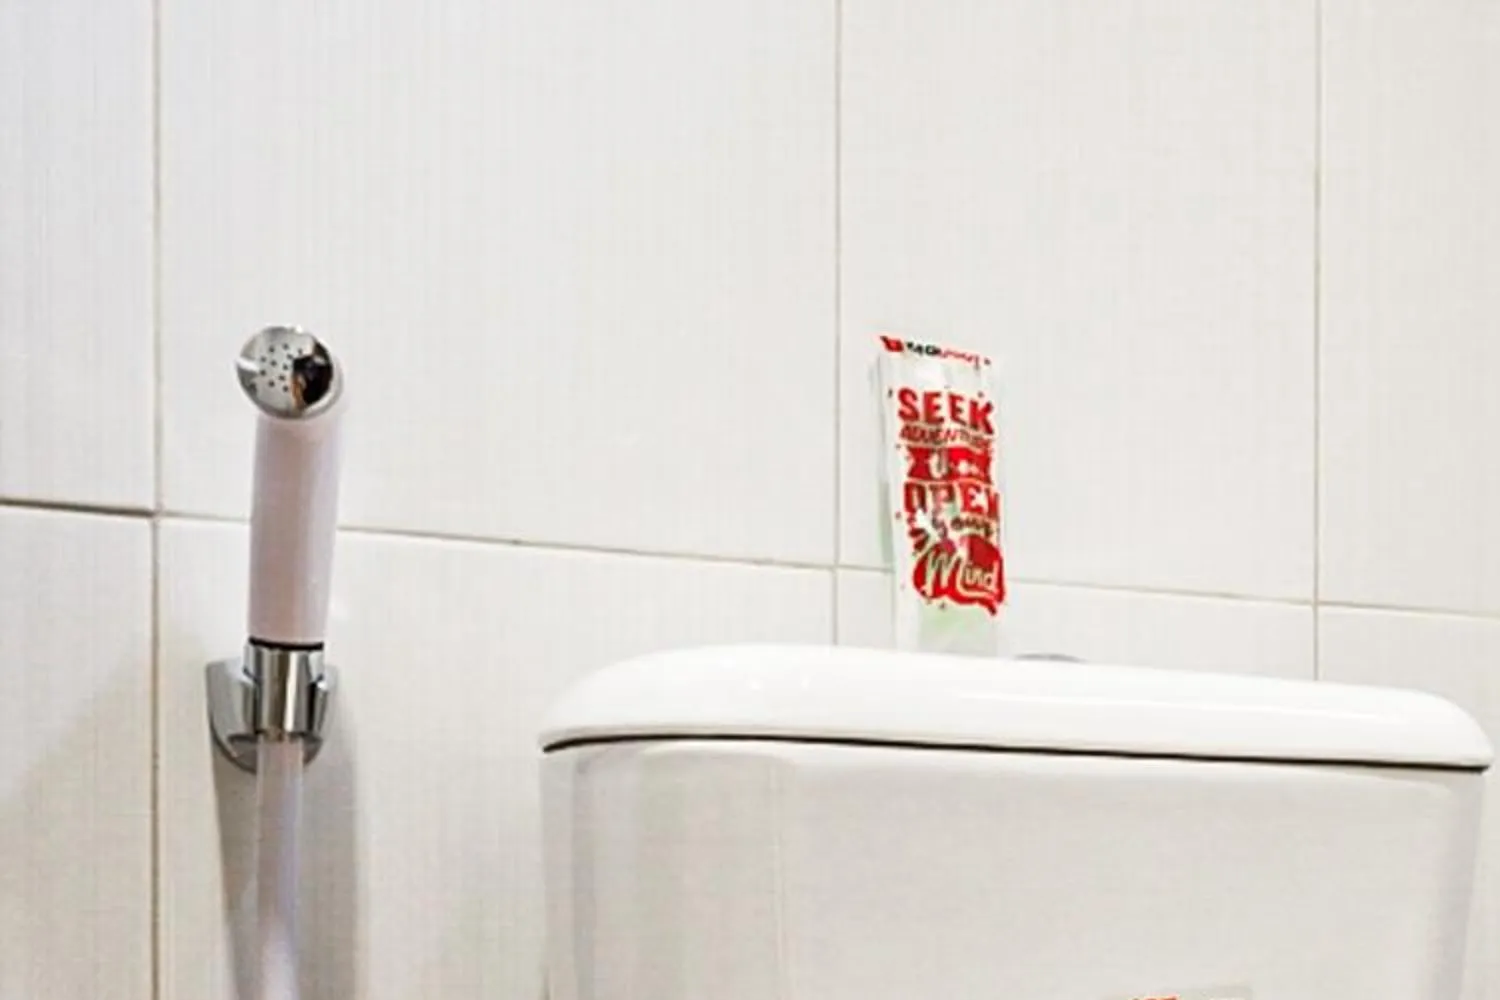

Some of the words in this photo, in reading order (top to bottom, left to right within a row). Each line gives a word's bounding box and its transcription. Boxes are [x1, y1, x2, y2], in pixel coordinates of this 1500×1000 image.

[898, 387, 994, 435] SEEK
[905, 481, 999, 520] OPEN
[922, 550, 998, 599] Mind
